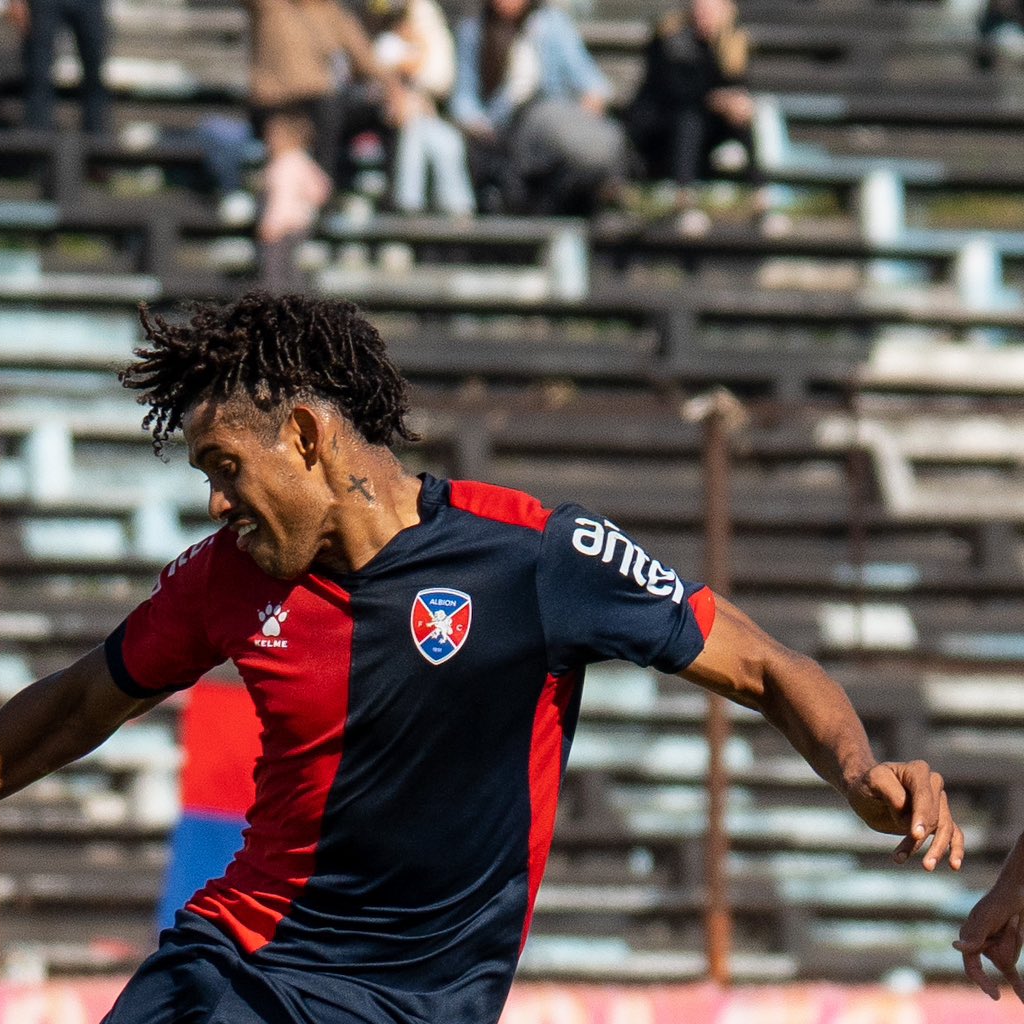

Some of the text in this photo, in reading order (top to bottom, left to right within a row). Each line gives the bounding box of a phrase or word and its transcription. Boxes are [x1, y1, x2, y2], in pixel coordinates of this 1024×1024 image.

[572, 517, 684, 604] antel
[429, 598, 457, 606] ALBION
[254, 640, 288, 648] KELME
